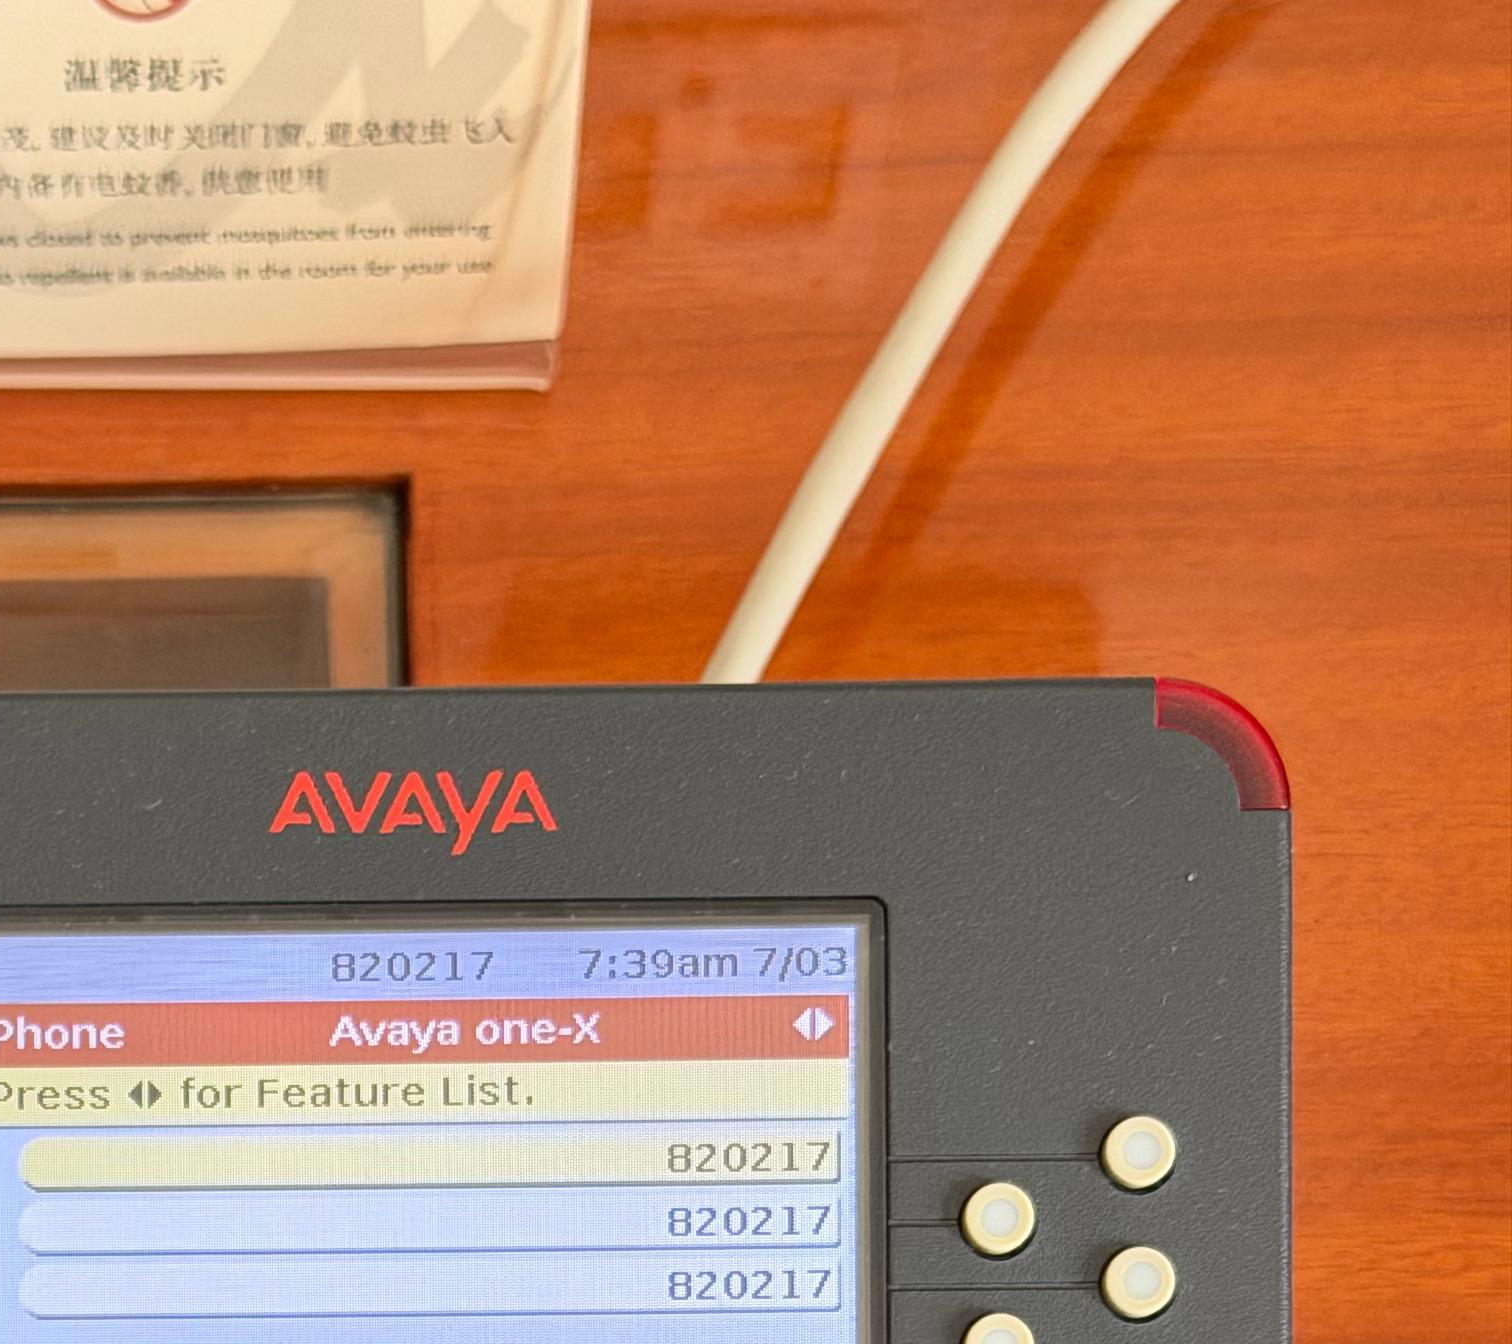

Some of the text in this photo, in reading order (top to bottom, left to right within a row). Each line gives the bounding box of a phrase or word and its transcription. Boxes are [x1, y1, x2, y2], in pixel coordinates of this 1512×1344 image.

[64, 57, 225, 92] 温馨提示
[269, 770, 558, 856] AVAYA
[332, 947, 848, 982] 820217 7:39am 7/03
[330, 1012, 600, 1054] Avaya one-X
[180, 1077, 242, 1109] for
[258, 1079, 424, 1108] Feature
[443, 1074, 532, 1106] List.
[668, 1142, 830, 1172] 820217
[668, 1206, 830, 1236] 820217
[668, 1269, 831, 1300] 820217
